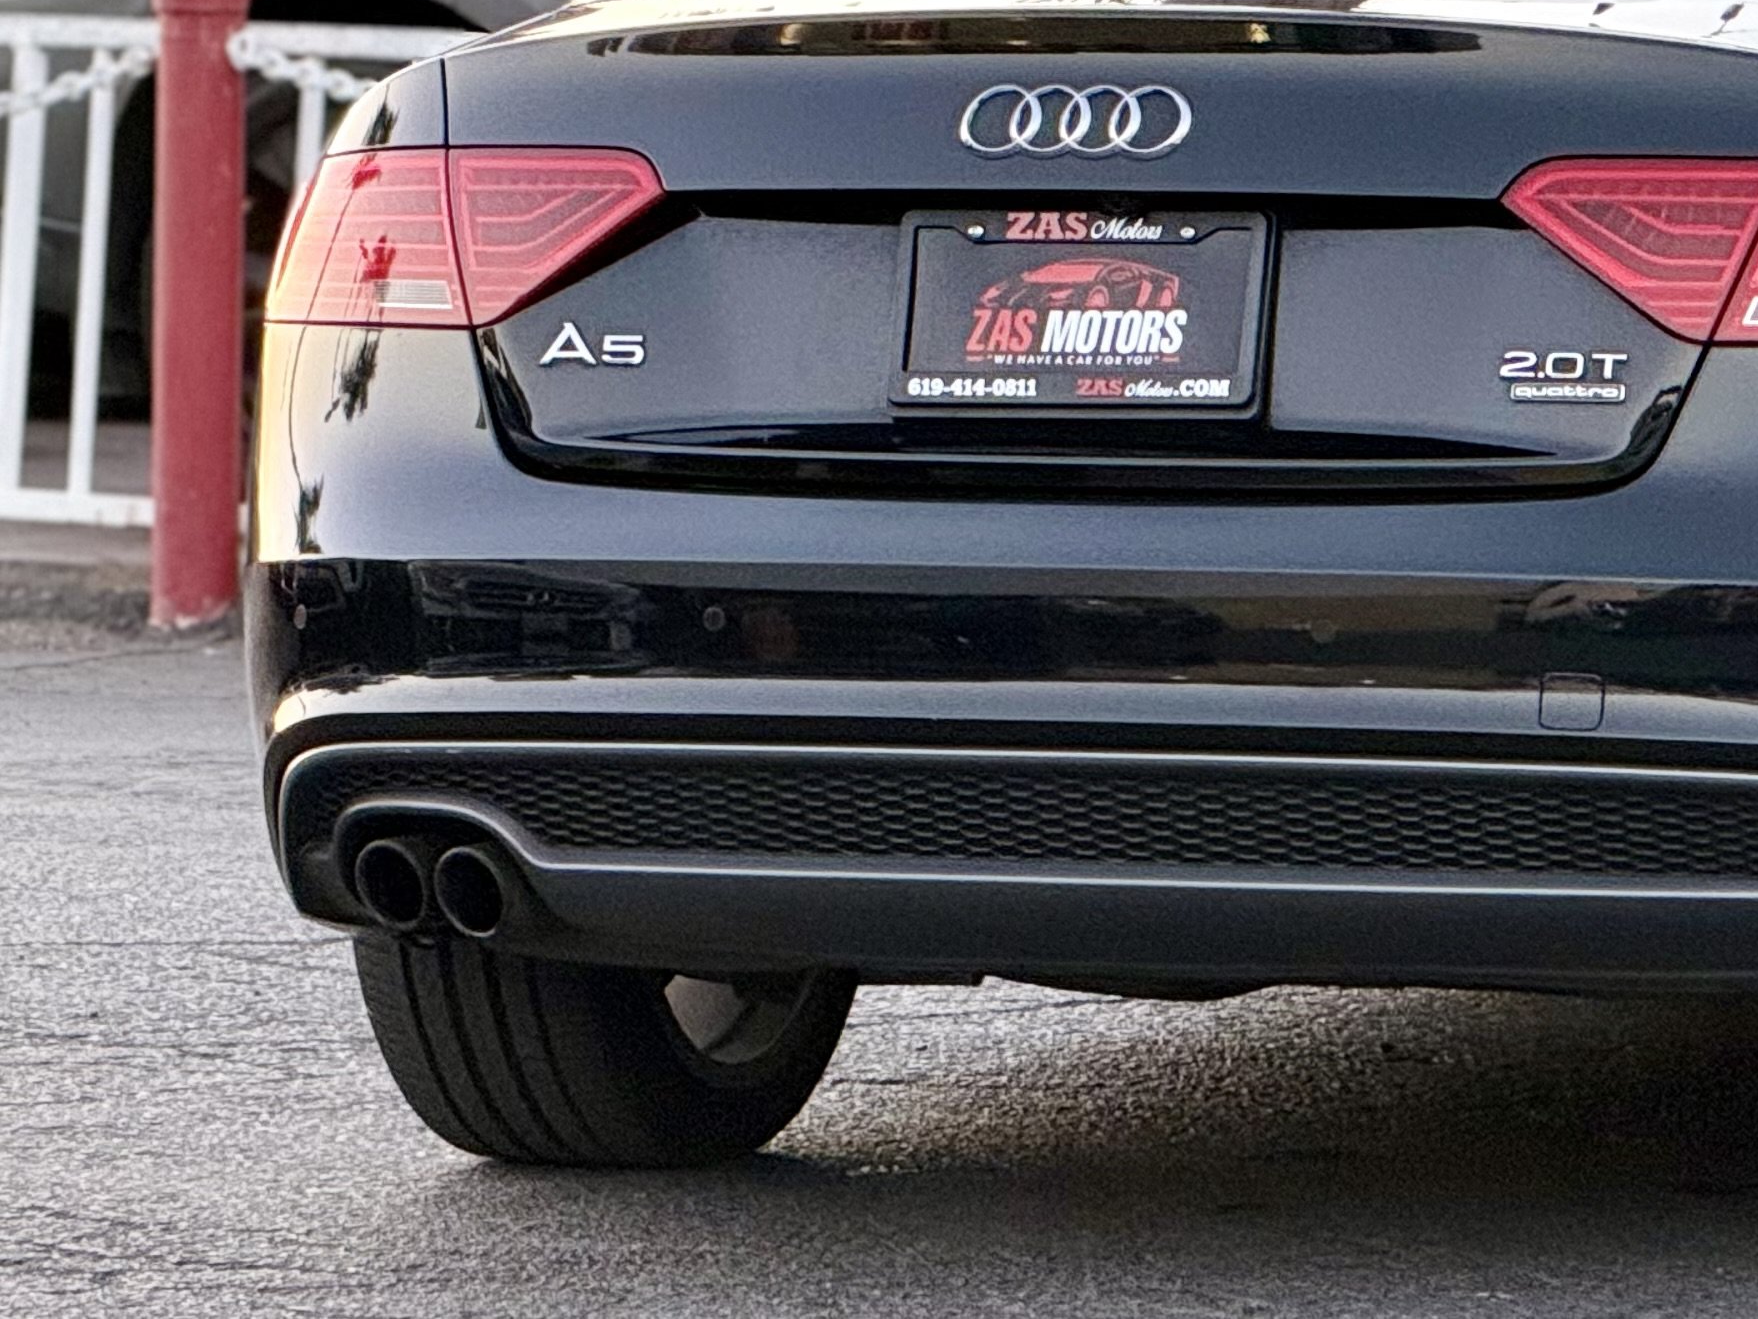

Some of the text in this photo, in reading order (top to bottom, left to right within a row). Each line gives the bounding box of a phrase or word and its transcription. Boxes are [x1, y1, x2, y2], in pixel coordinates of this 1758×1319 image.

[1005, 211, 1164, 241] ZAS Motors
[539, 321, 645, 366] A5
[965, 308, 1188, 355] ZAS MOTORS
[1016, 354, 1050, 366] HAVE
[1054, 354, 1064, 366] A
[1066, 354, 1093, 366] CAR
[1096, 354, 1123, 366] FOR
[1499, 350, 1629, 380] 2.0T
[907, 377, 1037, 397] 619-414-0811
[1513, 384, 1620, 400] quattro
